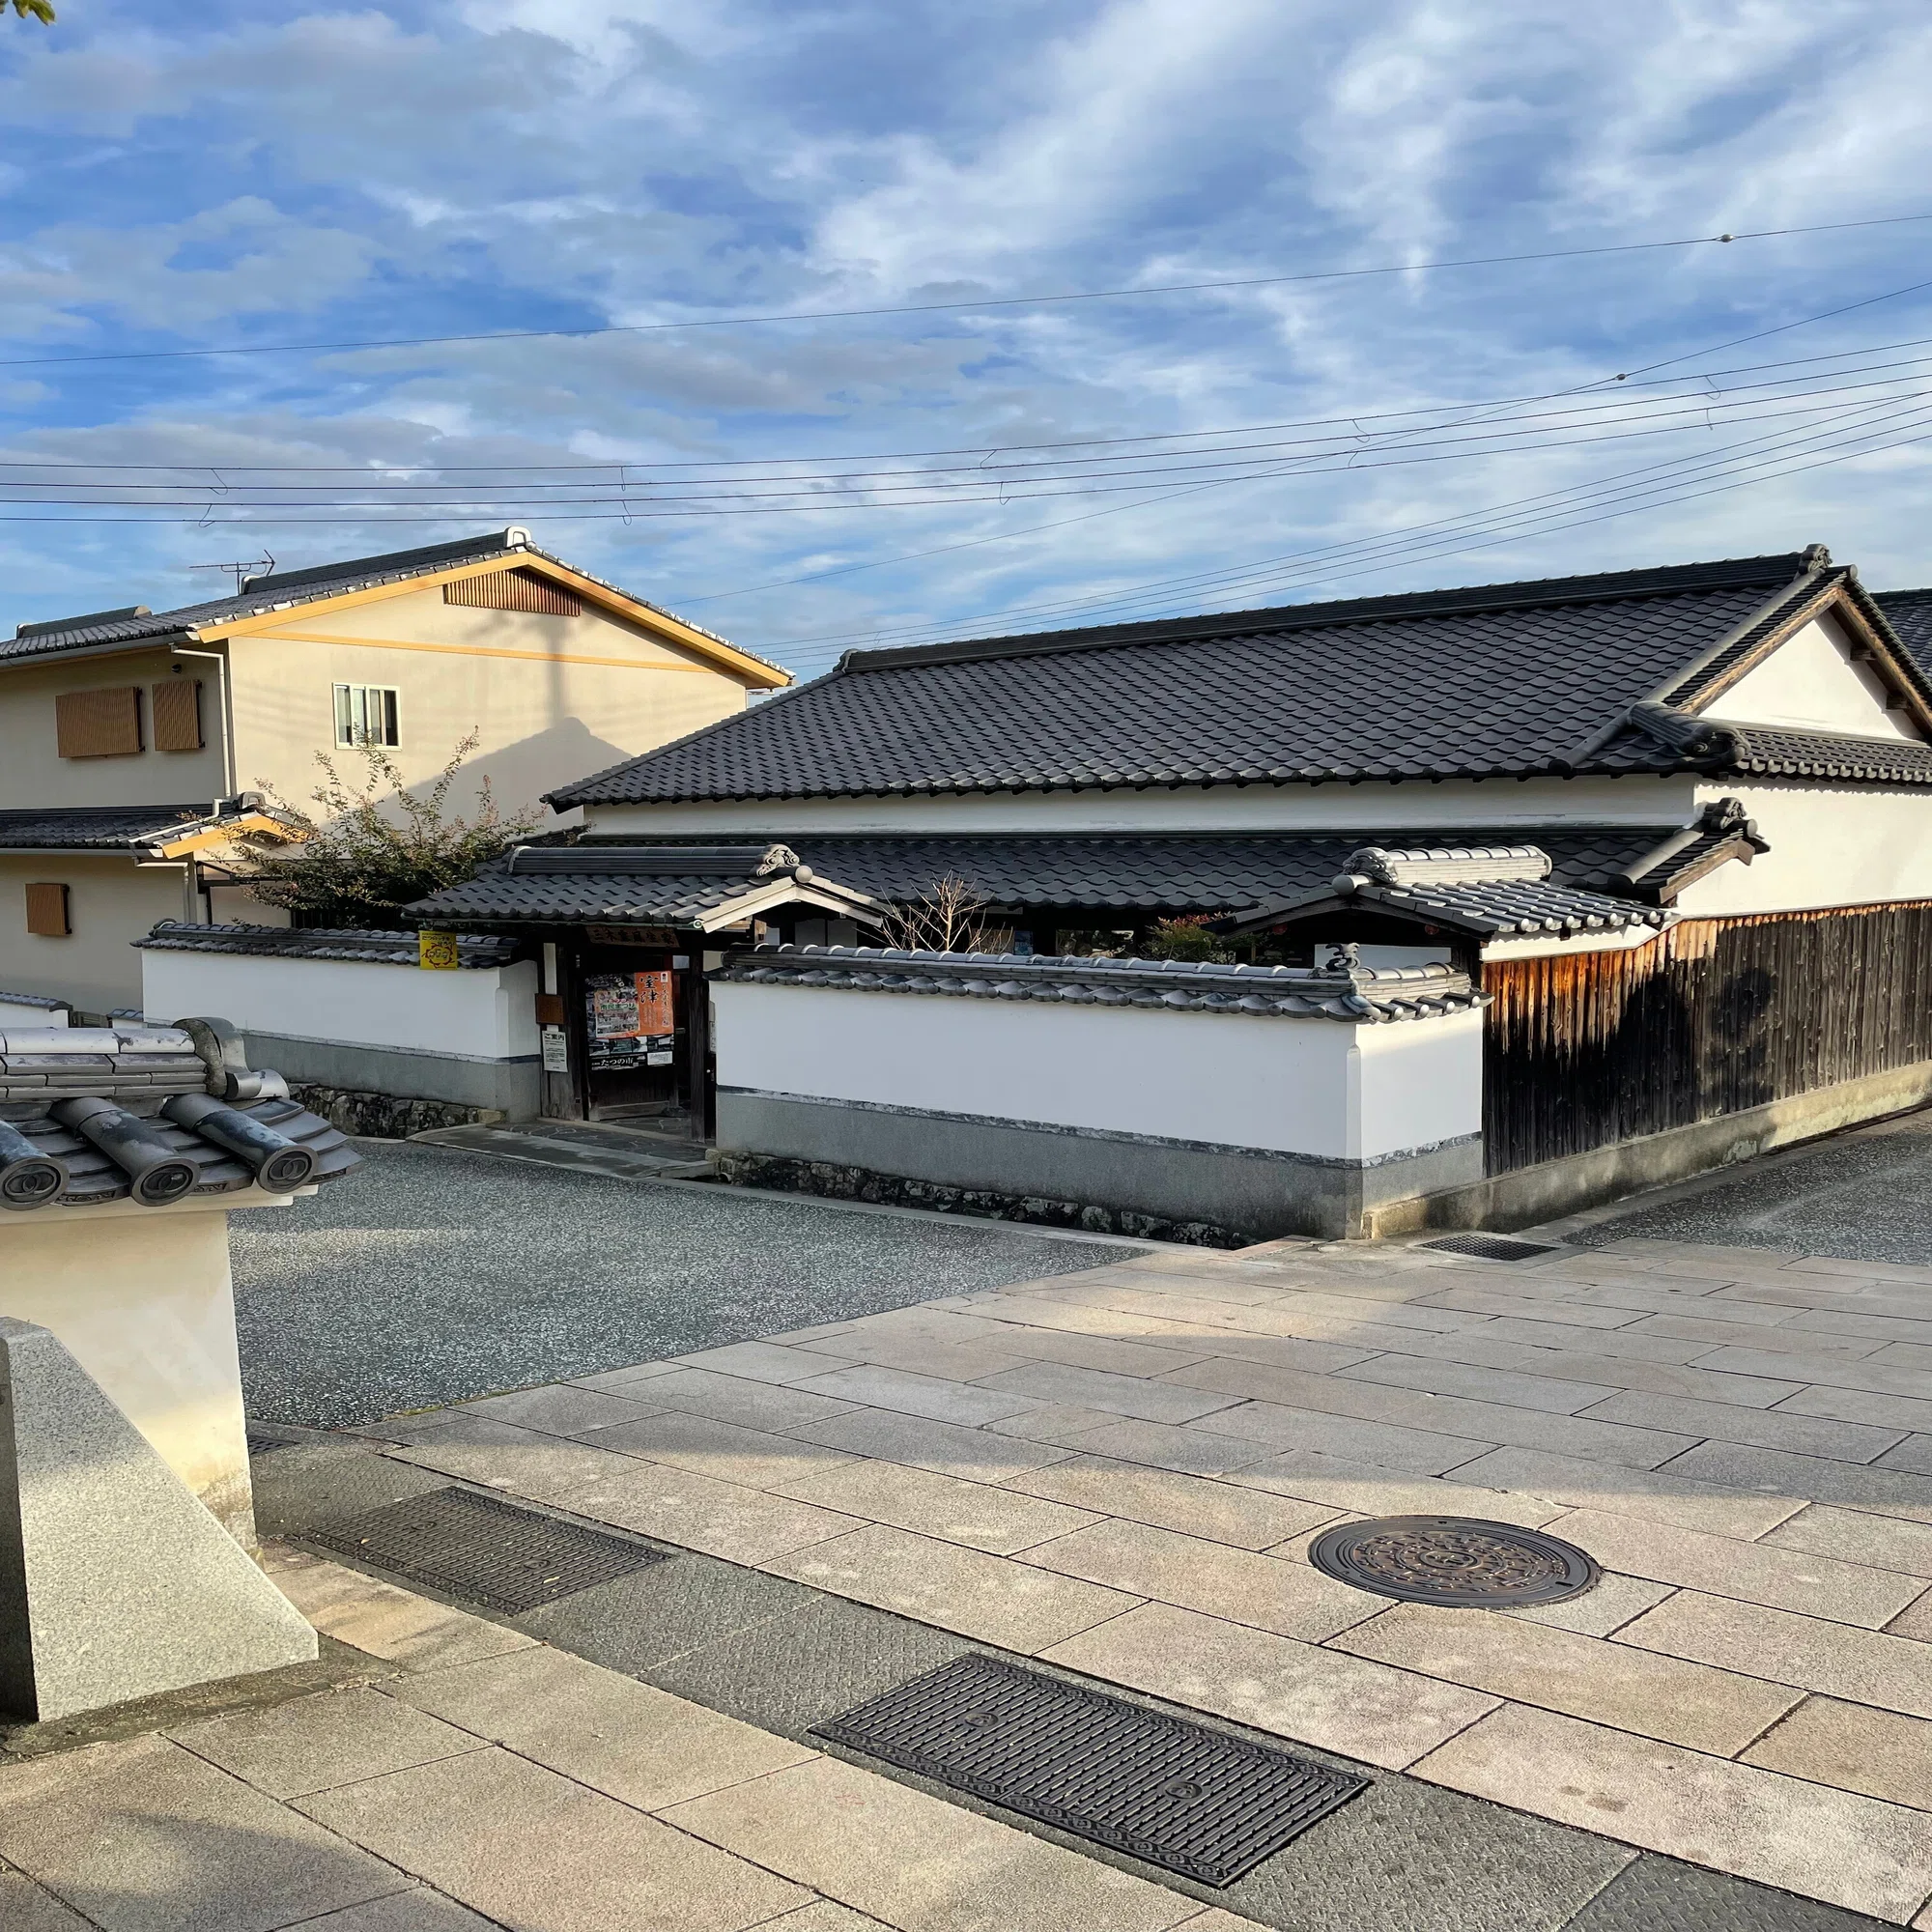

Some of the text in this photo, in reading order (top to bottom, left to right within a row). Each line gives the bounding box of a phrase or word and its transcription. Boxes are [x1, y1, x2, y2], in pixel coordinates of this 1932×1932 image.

[639, 975, 659, 1003] 室津
[600, 1057, 634, 1066] たつの市
